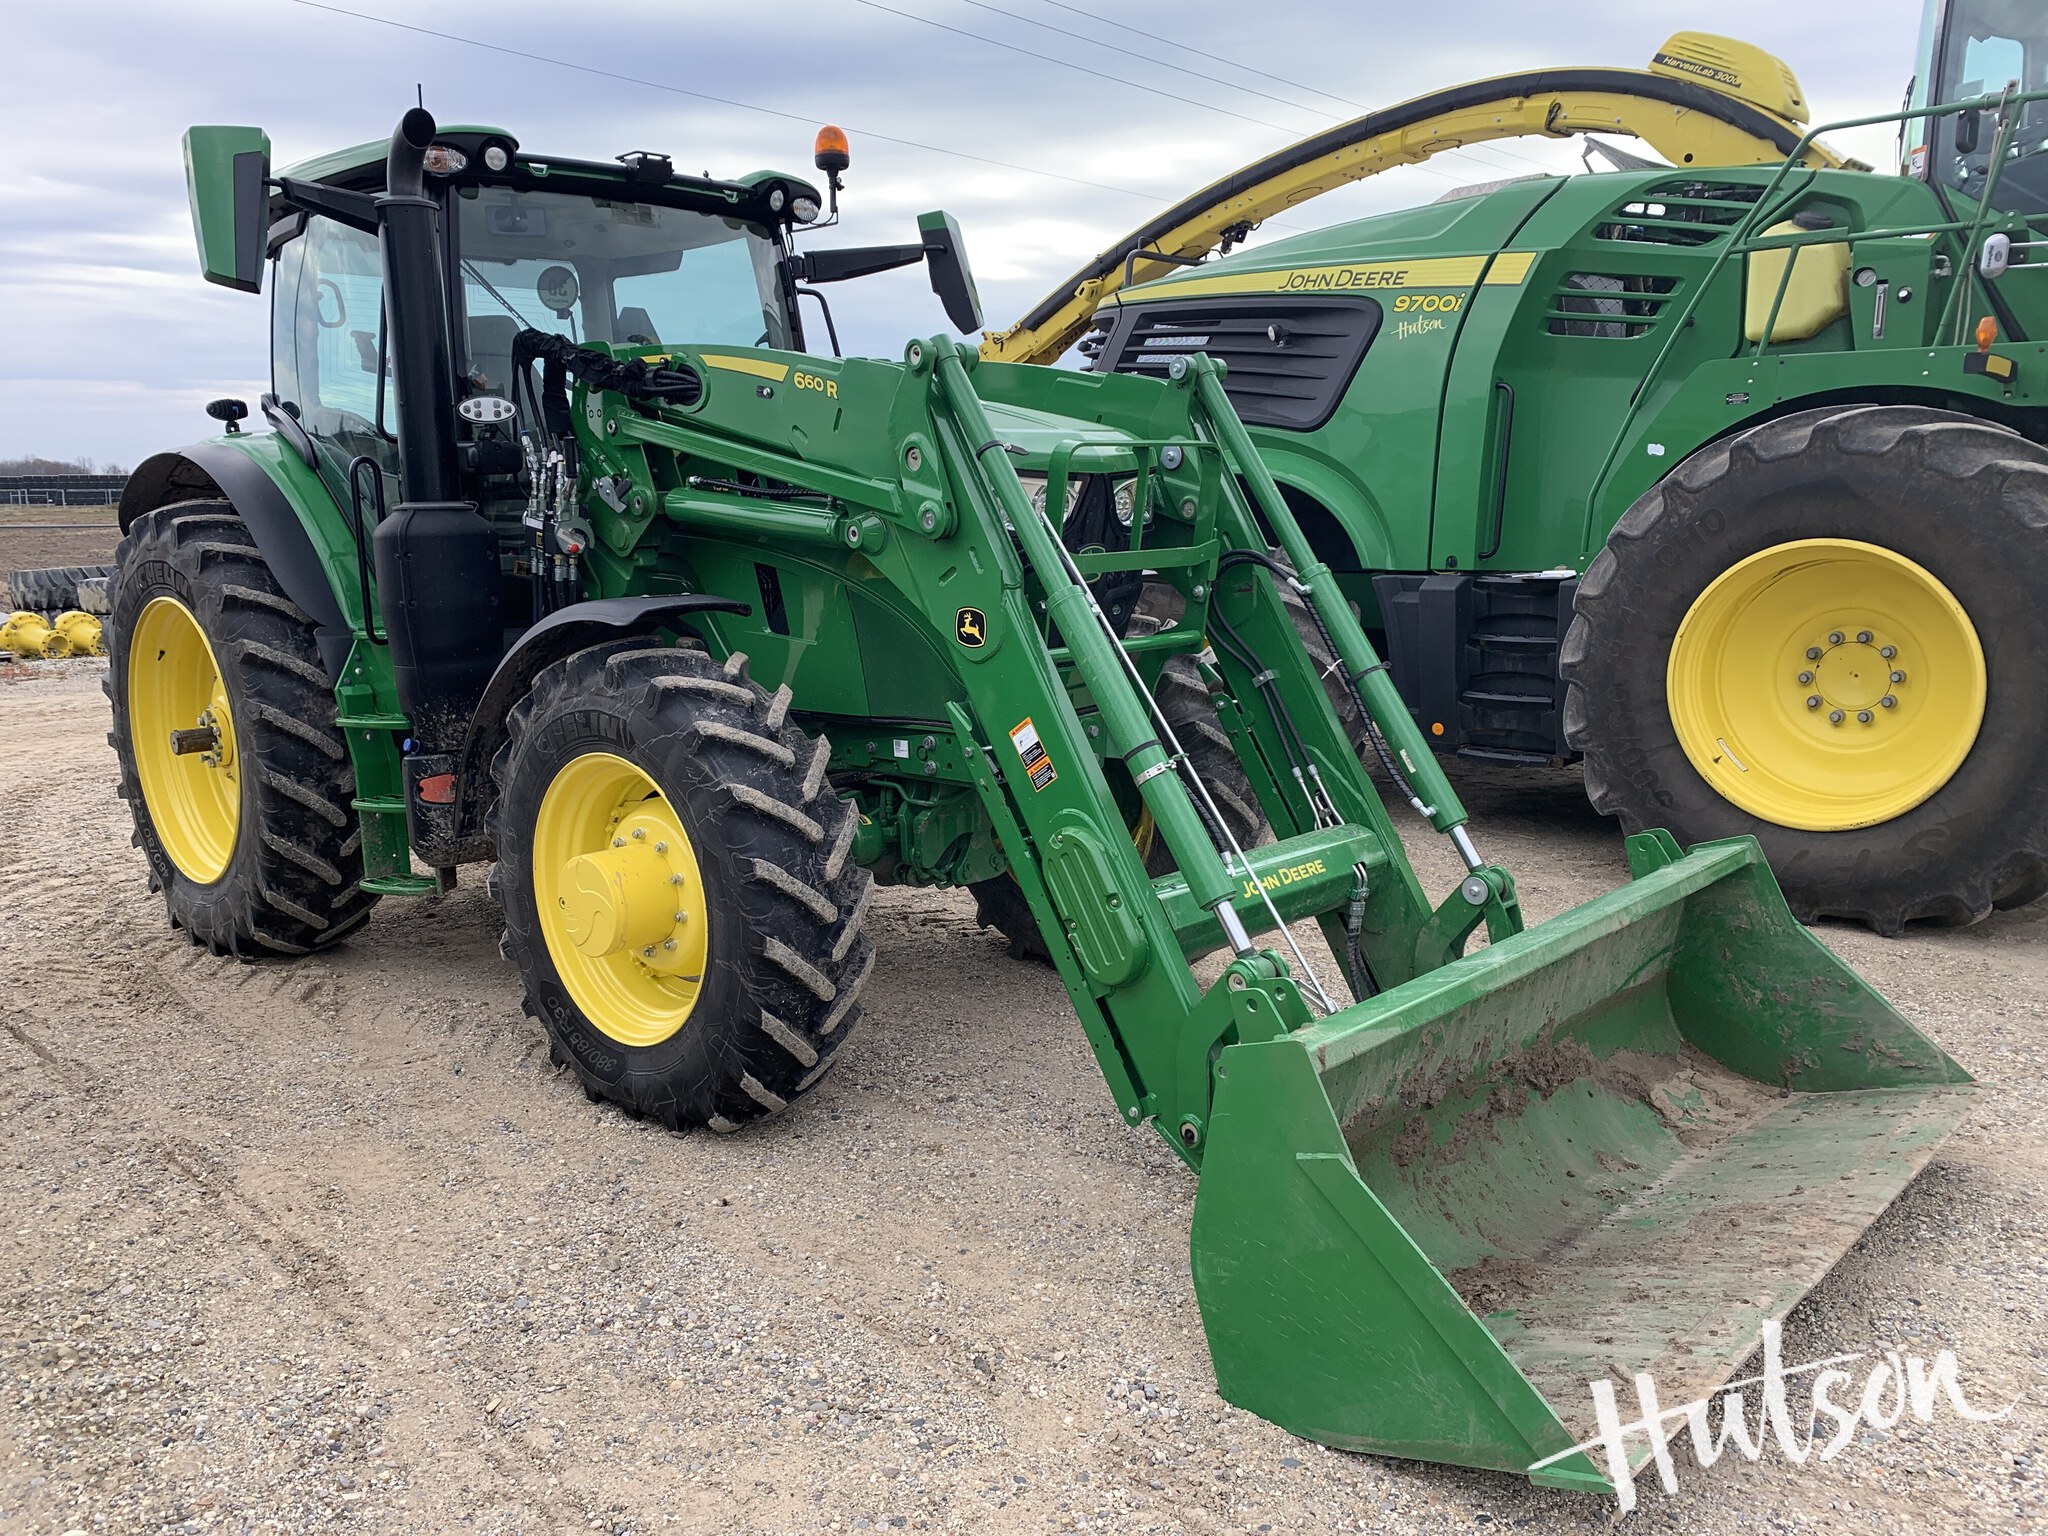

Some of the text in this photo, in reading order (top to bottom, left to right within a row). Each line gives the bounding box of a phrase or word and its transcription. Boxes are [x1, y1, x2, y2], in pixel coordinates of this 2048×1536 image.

[1662, 56, 1714, 77] HarvestLab
[1278, 269, 1409, 290] JOHN DEERE
[1392, 292, 1467, 313] 9700i
[1390, 315, 1448, 340] Hutson
[793, 370, 839, 400] 660 R
[1243, 859, 1327, 899] JOHN DEERE
[568, 1030, 618, 1073] 380/85
